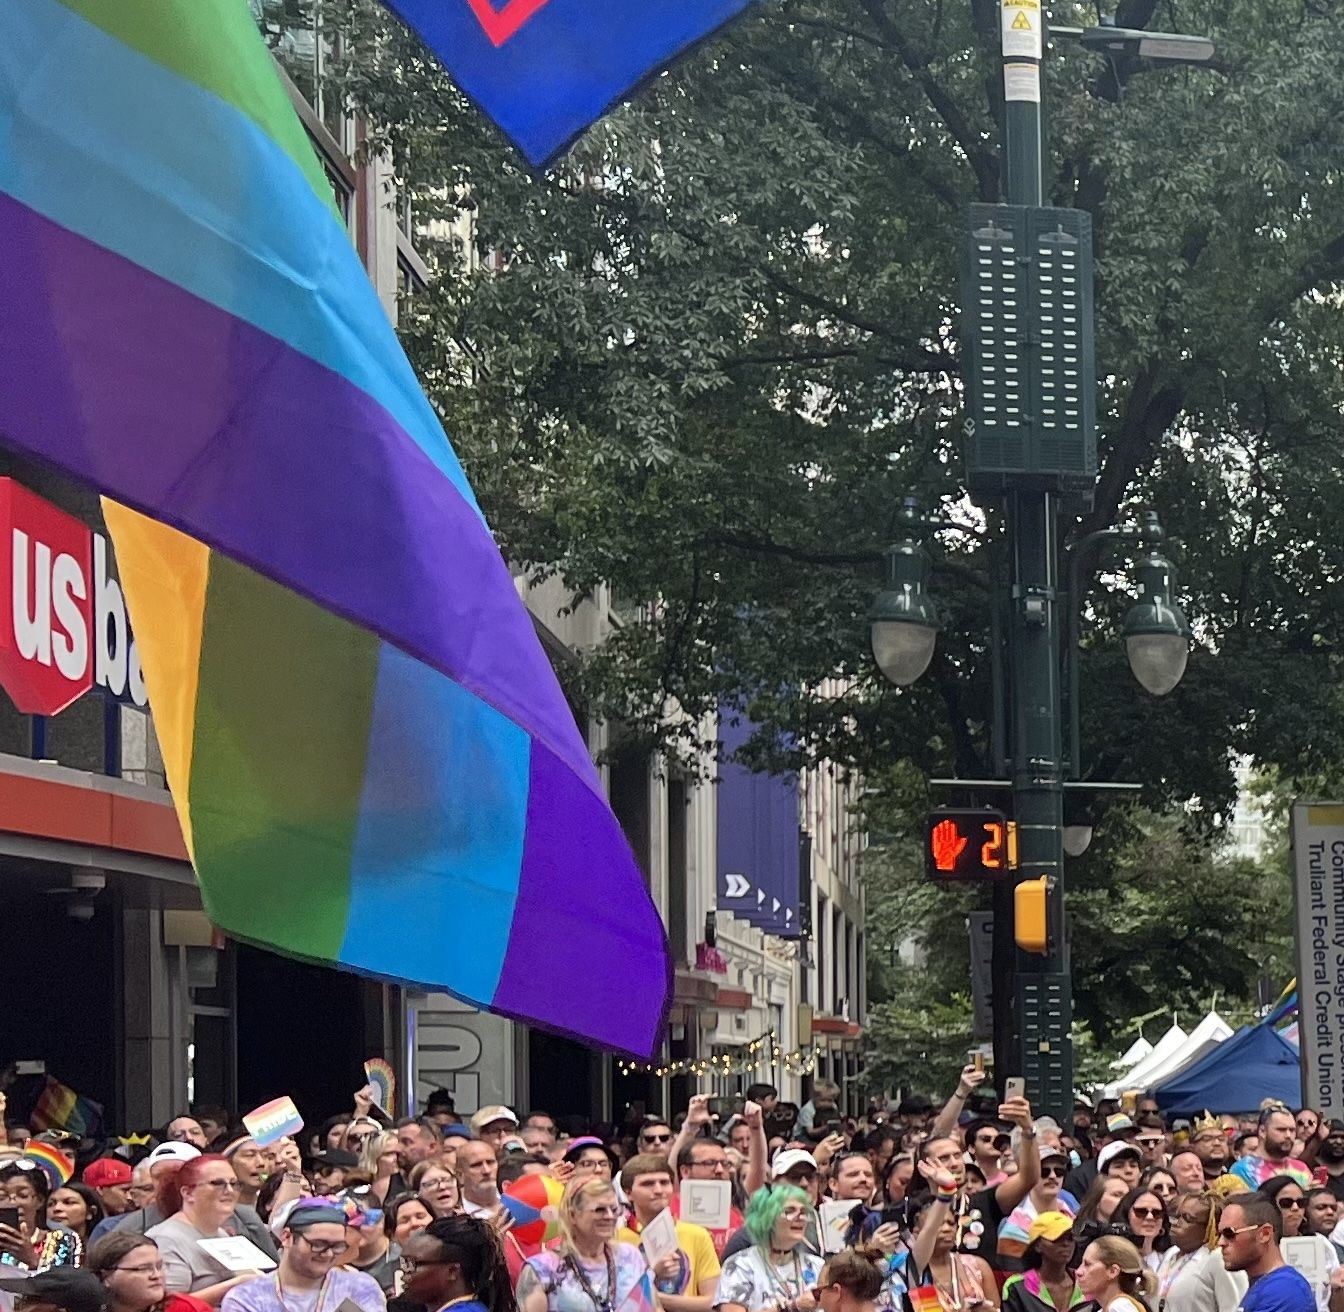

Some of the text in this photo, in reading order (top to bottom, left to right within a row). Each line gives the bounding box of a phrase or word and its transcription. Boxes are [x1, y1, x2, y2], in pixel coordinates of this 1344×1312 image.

[1309, 840, 1335, 1108] Truliant Federal Credit Union
